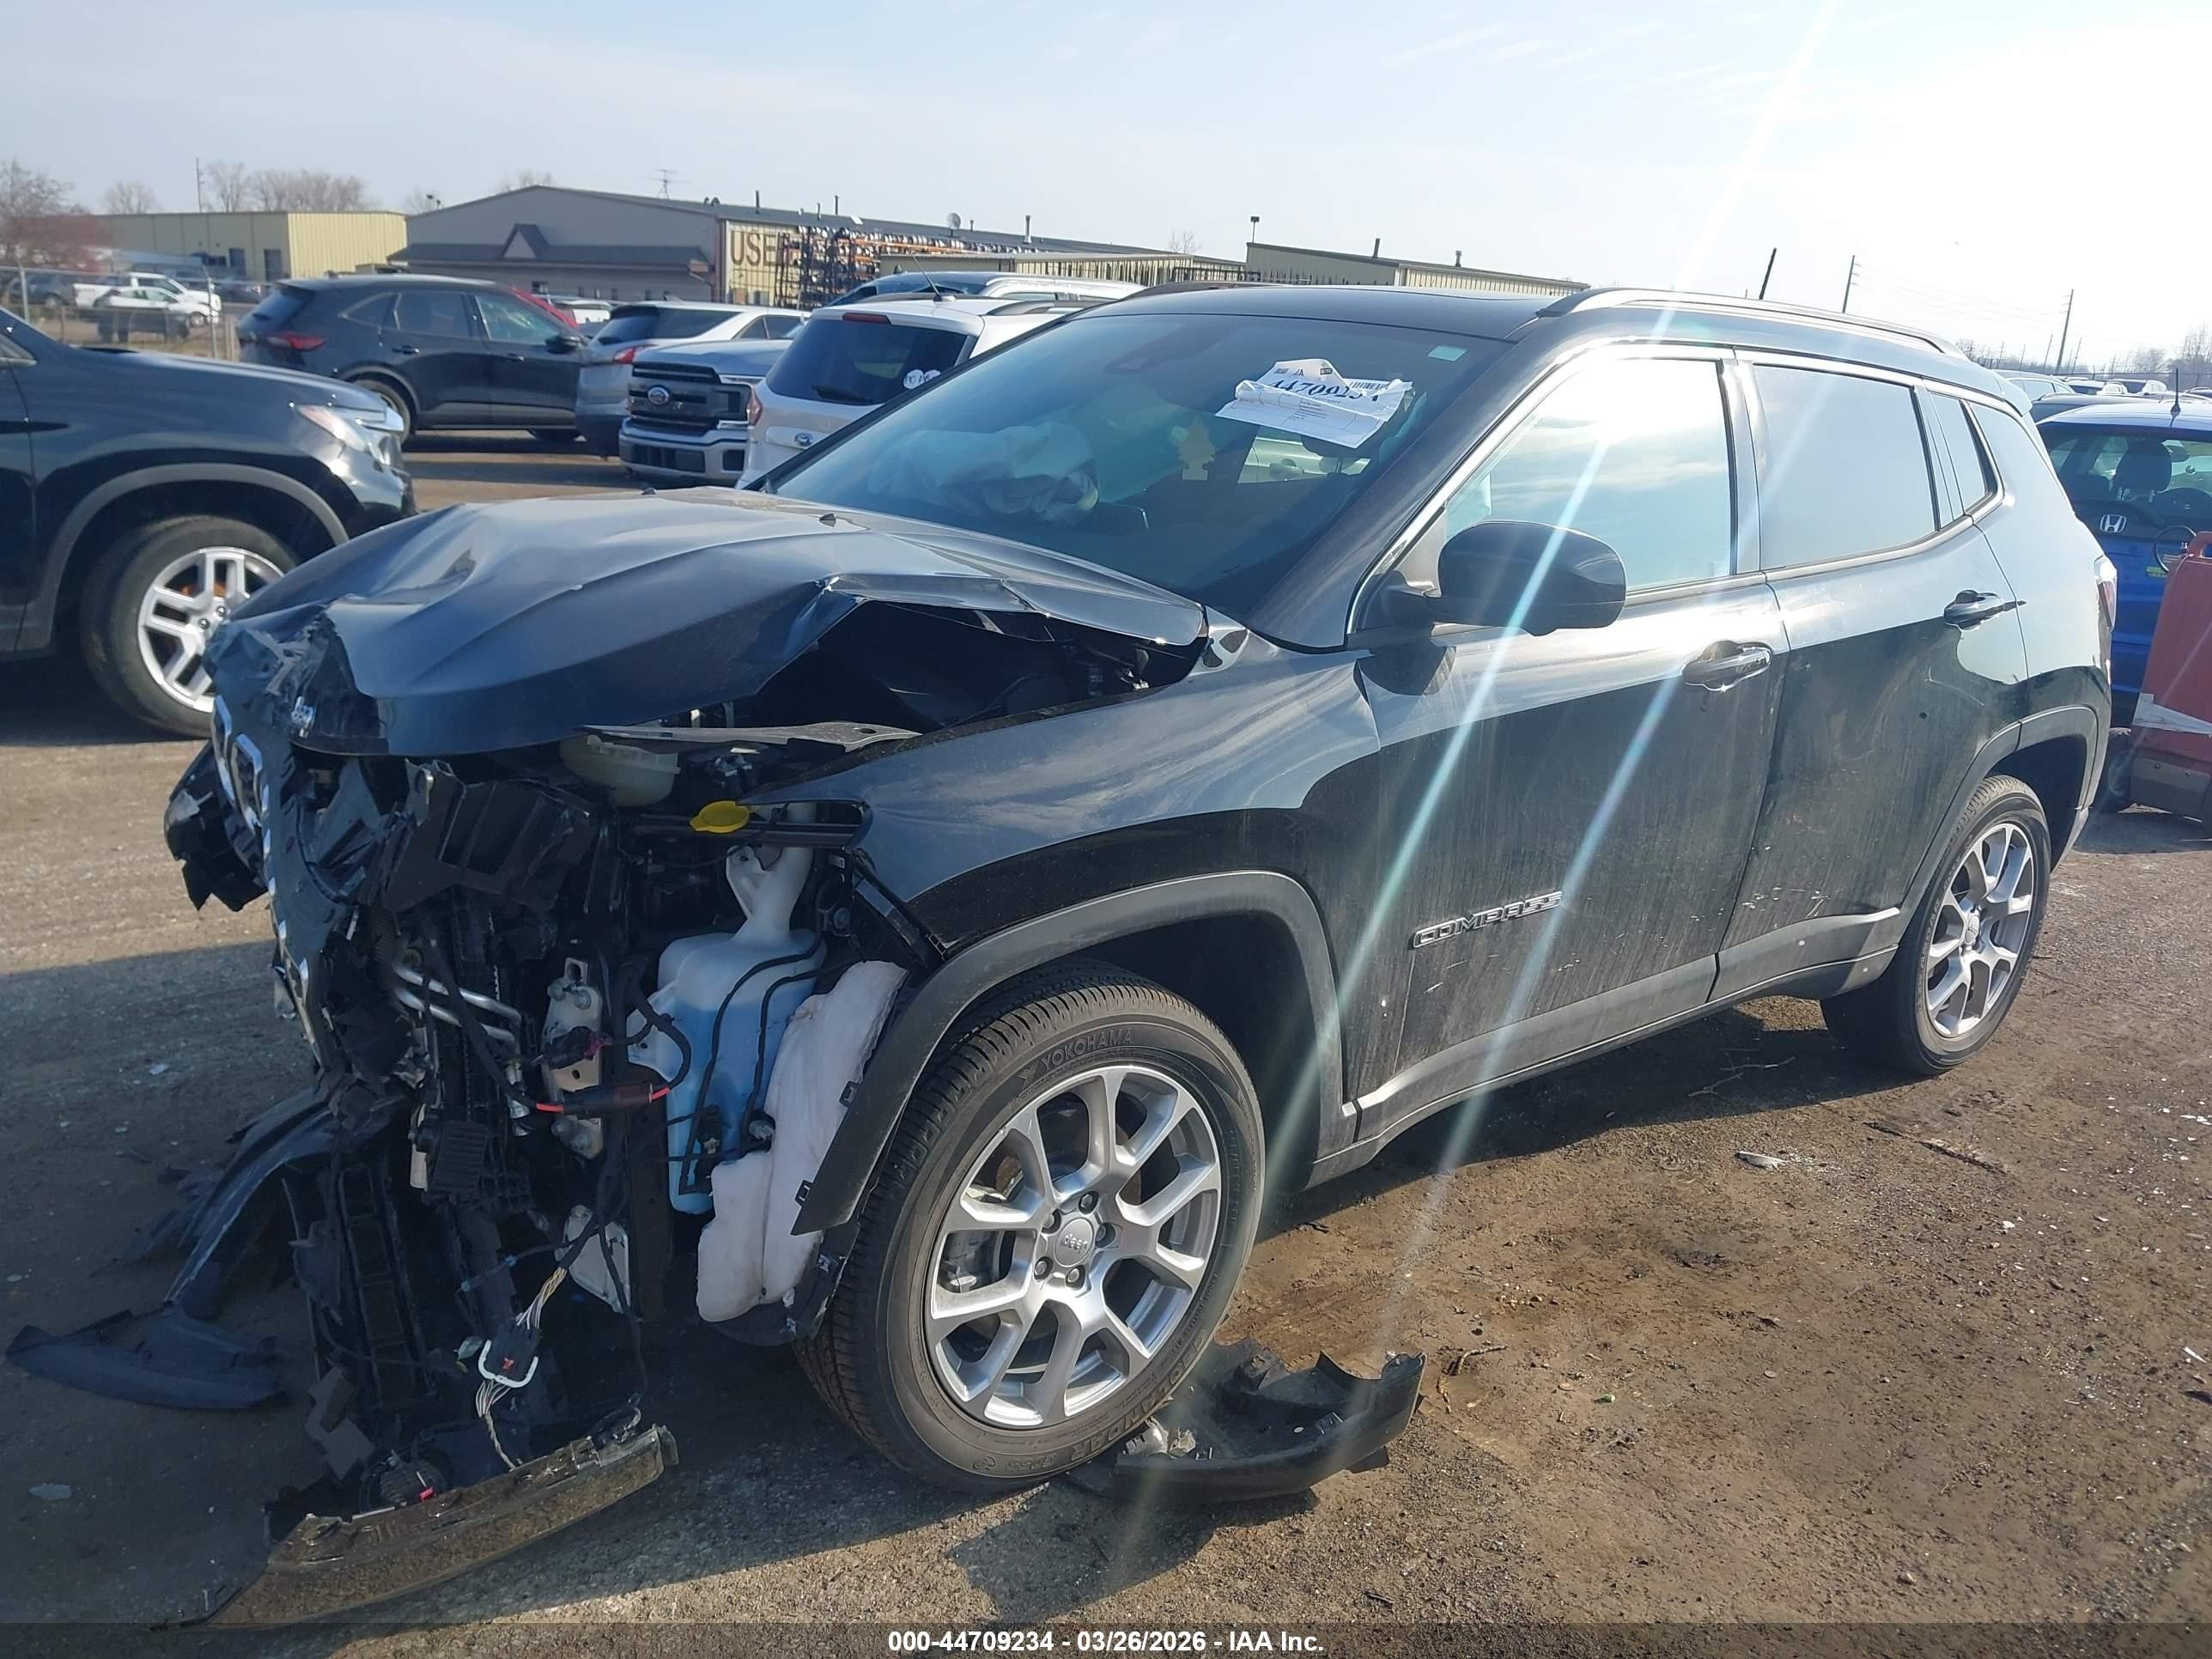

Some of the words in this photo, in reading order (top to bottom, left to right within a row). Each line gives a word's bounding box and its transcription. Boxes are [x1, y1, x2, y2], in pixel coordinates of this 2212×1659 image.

[731, 230, 789, 266] USE
[1413, 890, 1564, 948] COMPASS
[1041, 1028, 1133, 1071] YOKOHAMA
